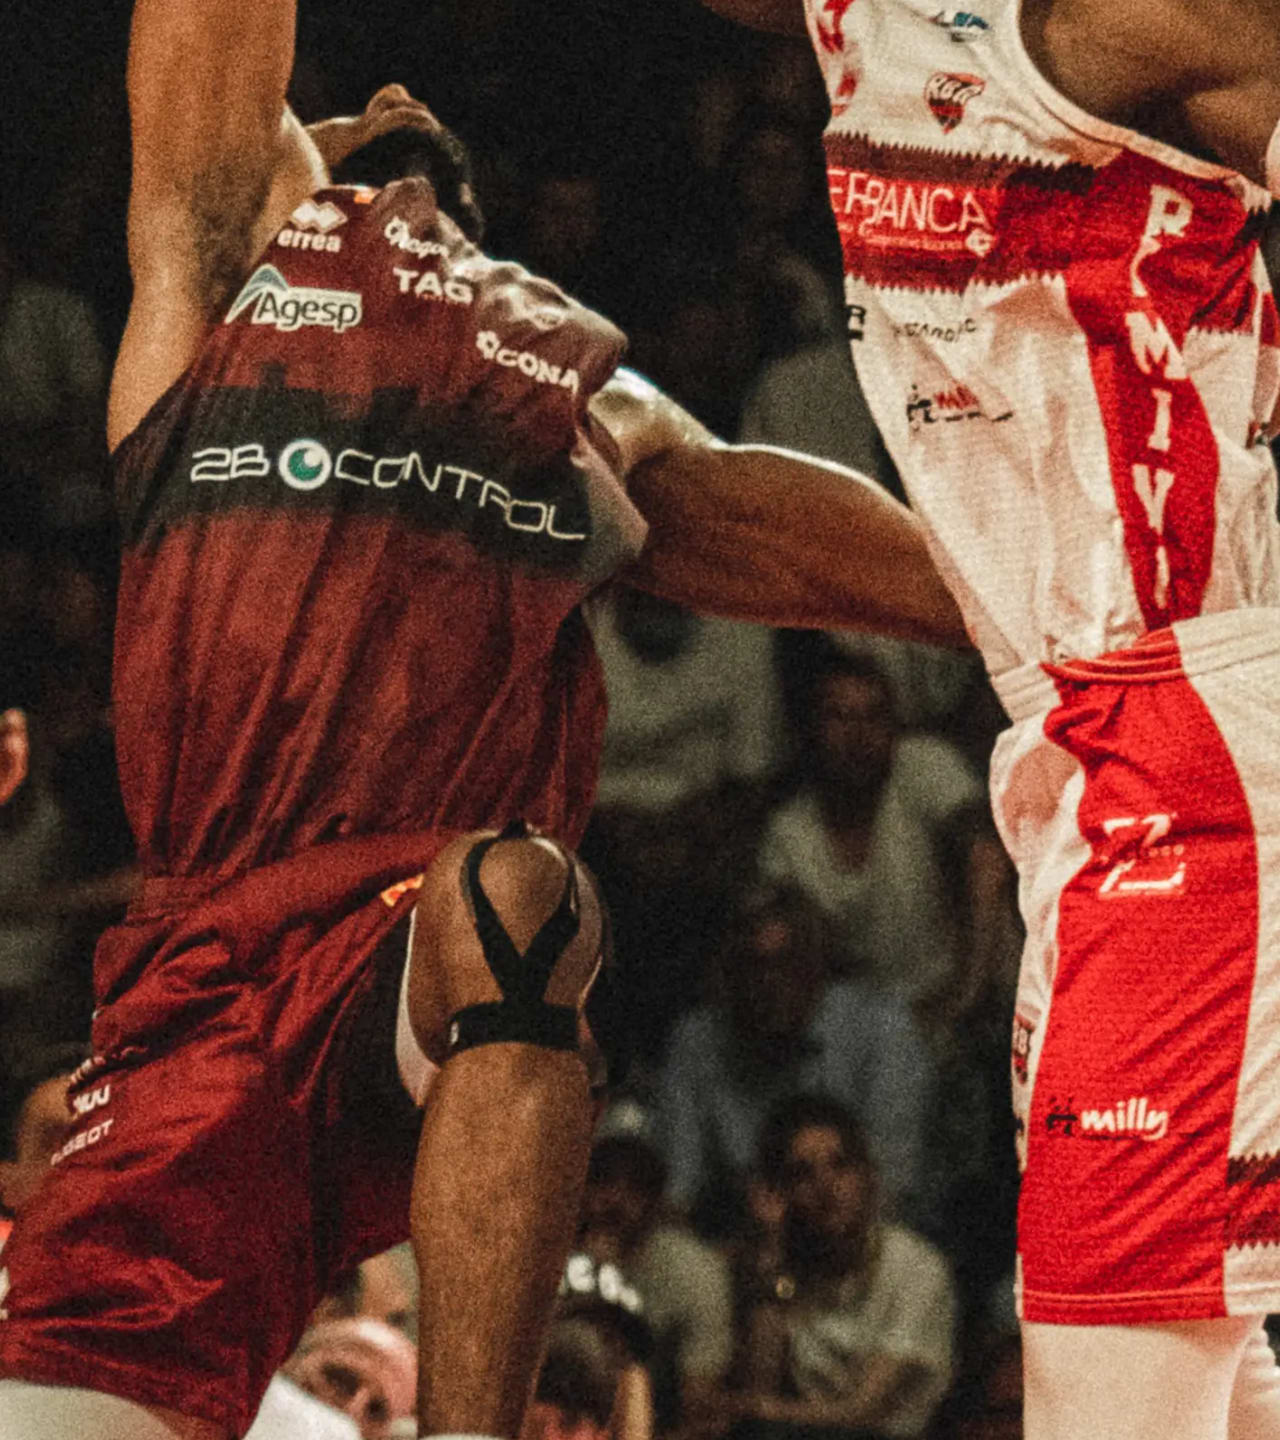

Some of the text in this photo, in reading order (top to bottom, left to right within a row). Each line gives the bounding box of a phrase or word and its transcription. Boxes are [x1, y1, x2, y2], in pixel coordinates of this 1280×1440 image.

[392, 267, 474, 304] TAG
[257, 290, 358, 329] Agesp
[190, 443, 586, 541] 2B CONTROL
[1081, 1097, 1169, 1142] milly
